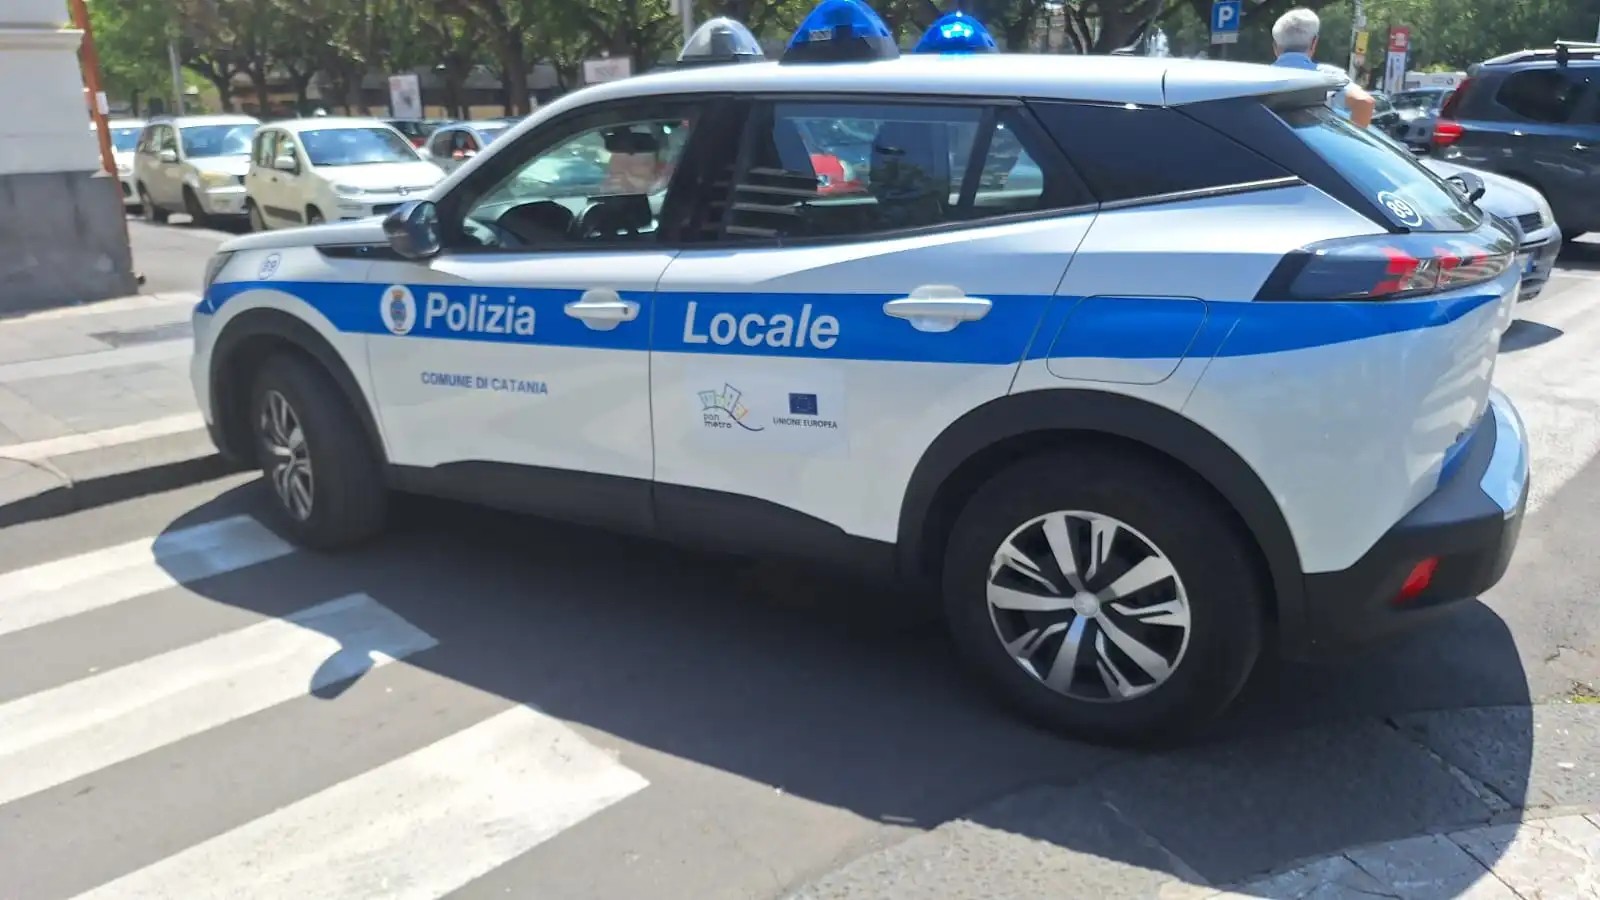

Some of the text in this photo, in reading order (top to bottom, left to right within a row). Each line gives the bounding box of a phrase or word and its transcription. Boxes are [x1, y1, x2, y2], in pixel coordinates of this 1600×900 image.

[1218, 6, 1233, 28] P
[1386, 199, 1413, 218] 89
[424, 292, 840, 349] Polizia Locale
[420, 371, 548, 395] COMUNE DI CATANIA
[704, 421, 732, 429] metro
[773, 416, 838, 429] UNIONE EUROPEA
